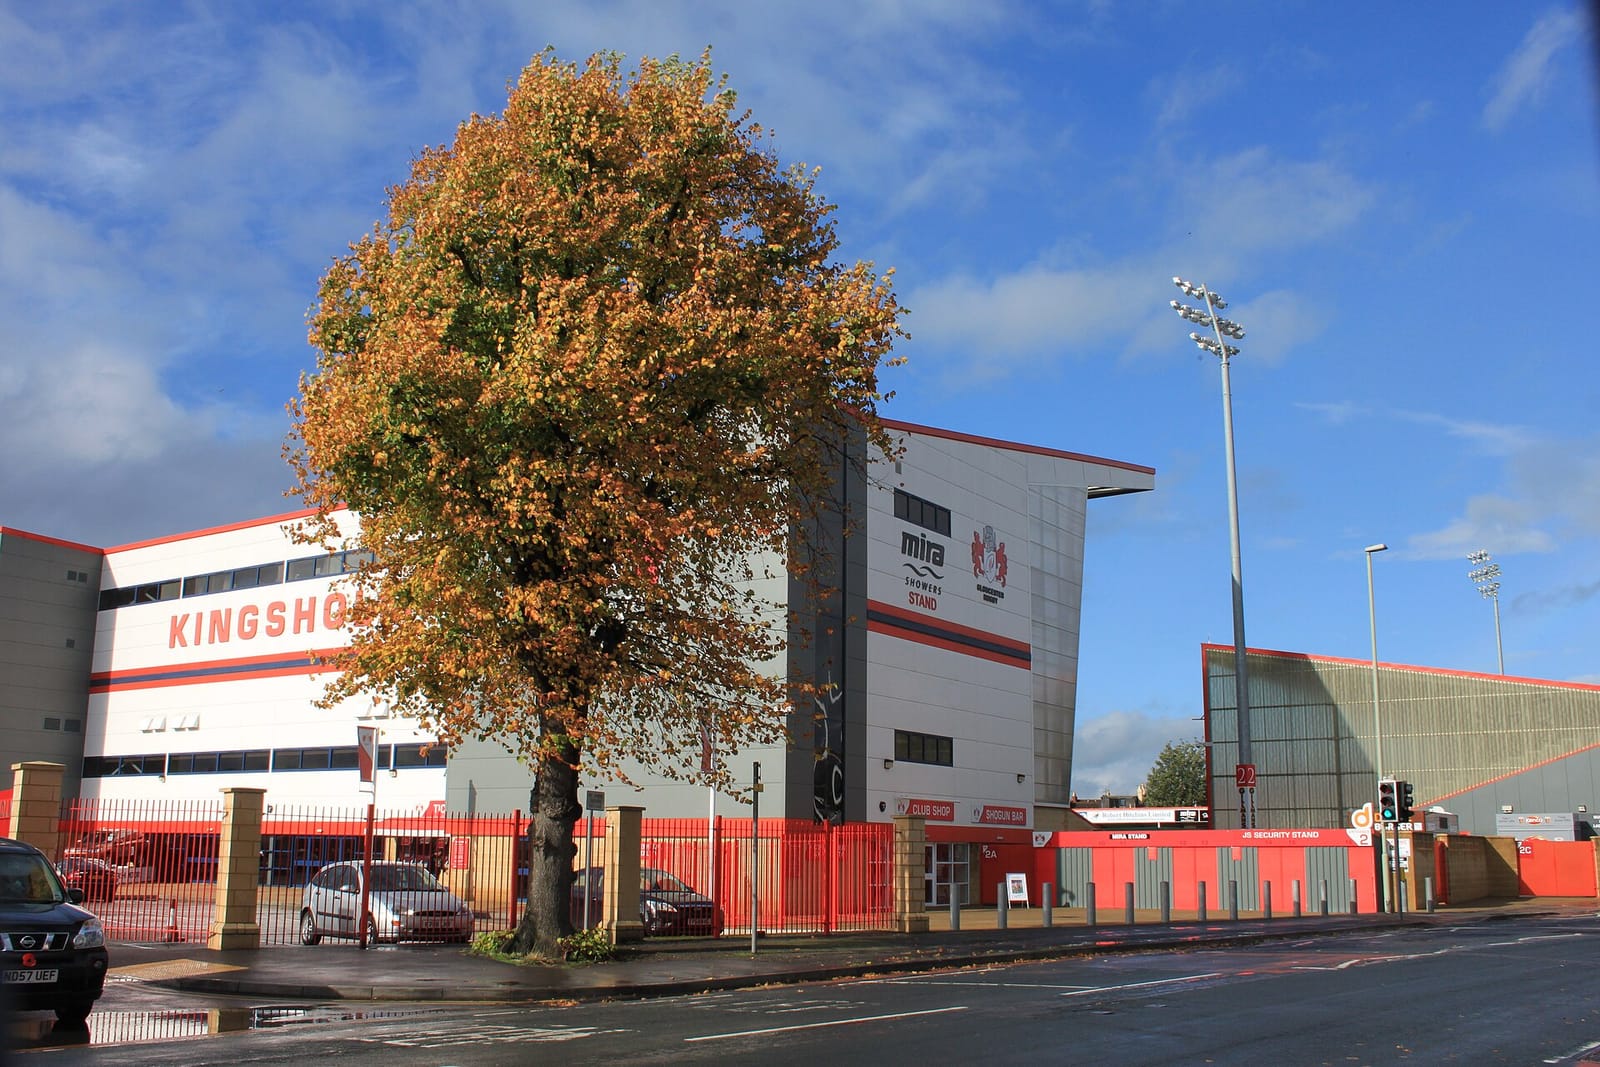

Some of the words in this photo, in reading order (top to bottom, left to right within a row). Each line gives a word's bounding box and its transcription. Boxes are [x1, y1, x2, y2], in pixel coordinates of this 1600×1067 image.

[901, 531, 945, 567] mira
[905, 576, 942, 595] SHOWERS
[908, 591, 937, 611] STAND
[912, 804, 931, 816] CLUB
[932, 805, 951, 817] SHOP
[986, 809, 1011, 820] SHOGUN
[1011, 811, 1024, 822] BAR
[1374, 822, 1413, 831] BRER
[1253, 831, 1291, 839] SECURITY
[1291, 831, 1319, 839] STAND
[1359, 833, 1369, 846] 2
[985, 848, 997, 859] 2A
[1519, 846, 1532, 854] 2C
[35, 970, 57, 981] UEF
